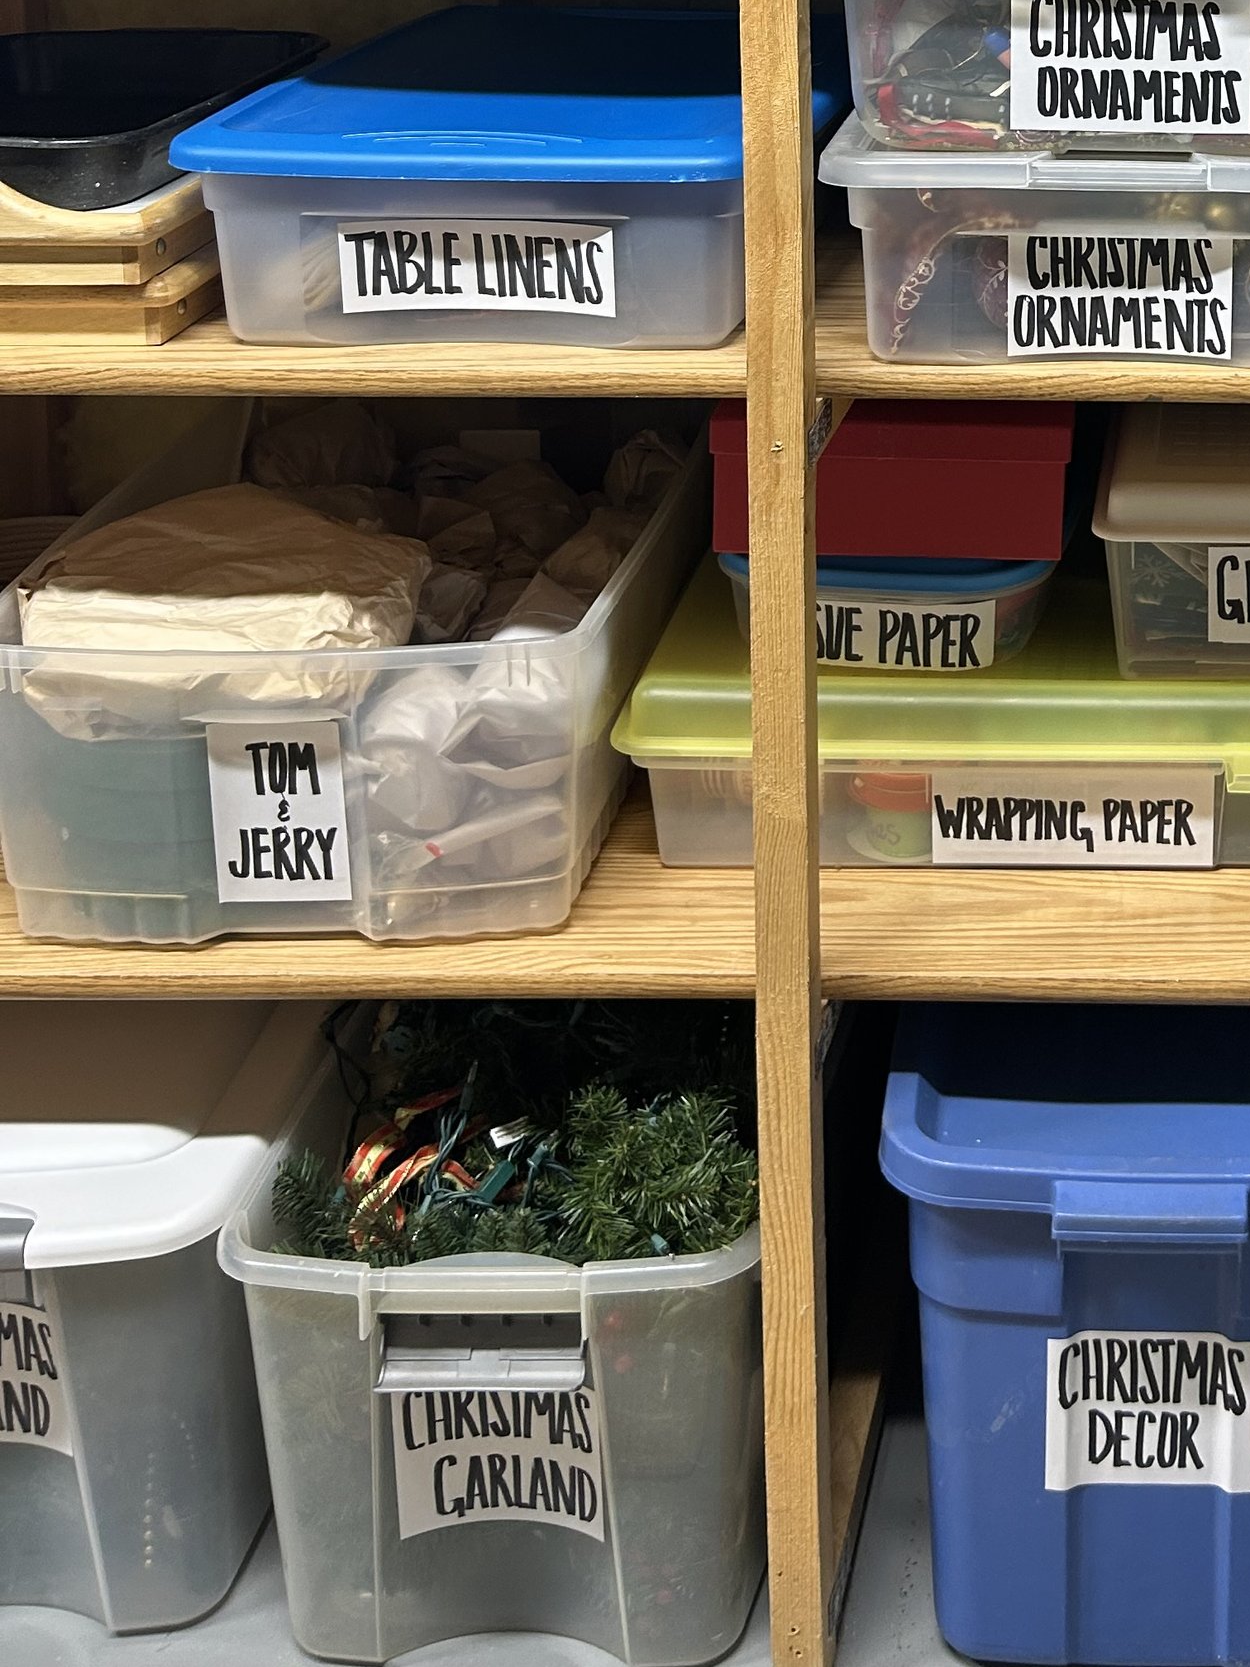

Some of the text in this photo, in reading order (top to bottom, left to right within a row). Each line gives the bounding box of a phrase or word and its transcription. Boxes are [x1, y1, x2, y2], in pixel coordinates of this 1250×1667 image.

[1038, 66, 1241, 124] ORNAMENTS
[344, 231, 602, 304] TABLE LINENS
[1027, 237, 1213, 294] CHRISTMAS
[1014, 295, 1227, 355] ORNAMENTS
[879, 610, 980, 667] PAPER
[245, 742, 320, 796] TOM
[935, 795, 1094, 852] WRAPPING
[1103, 799, 1195, 845] PAPER
[229, 827, 337, 880] JERRY
[0, 1313, 57, 1380] MAS
[1058, 1338, 1247, 1416] CHRISTMAS
[0, 1381, 49, 1436] ND
[403, 1391, 592, 1453] CHRISTMAS
[1089, 1410, 1203, 1469] DECOR
[434, 1454, 597, 1526] GARLAND
